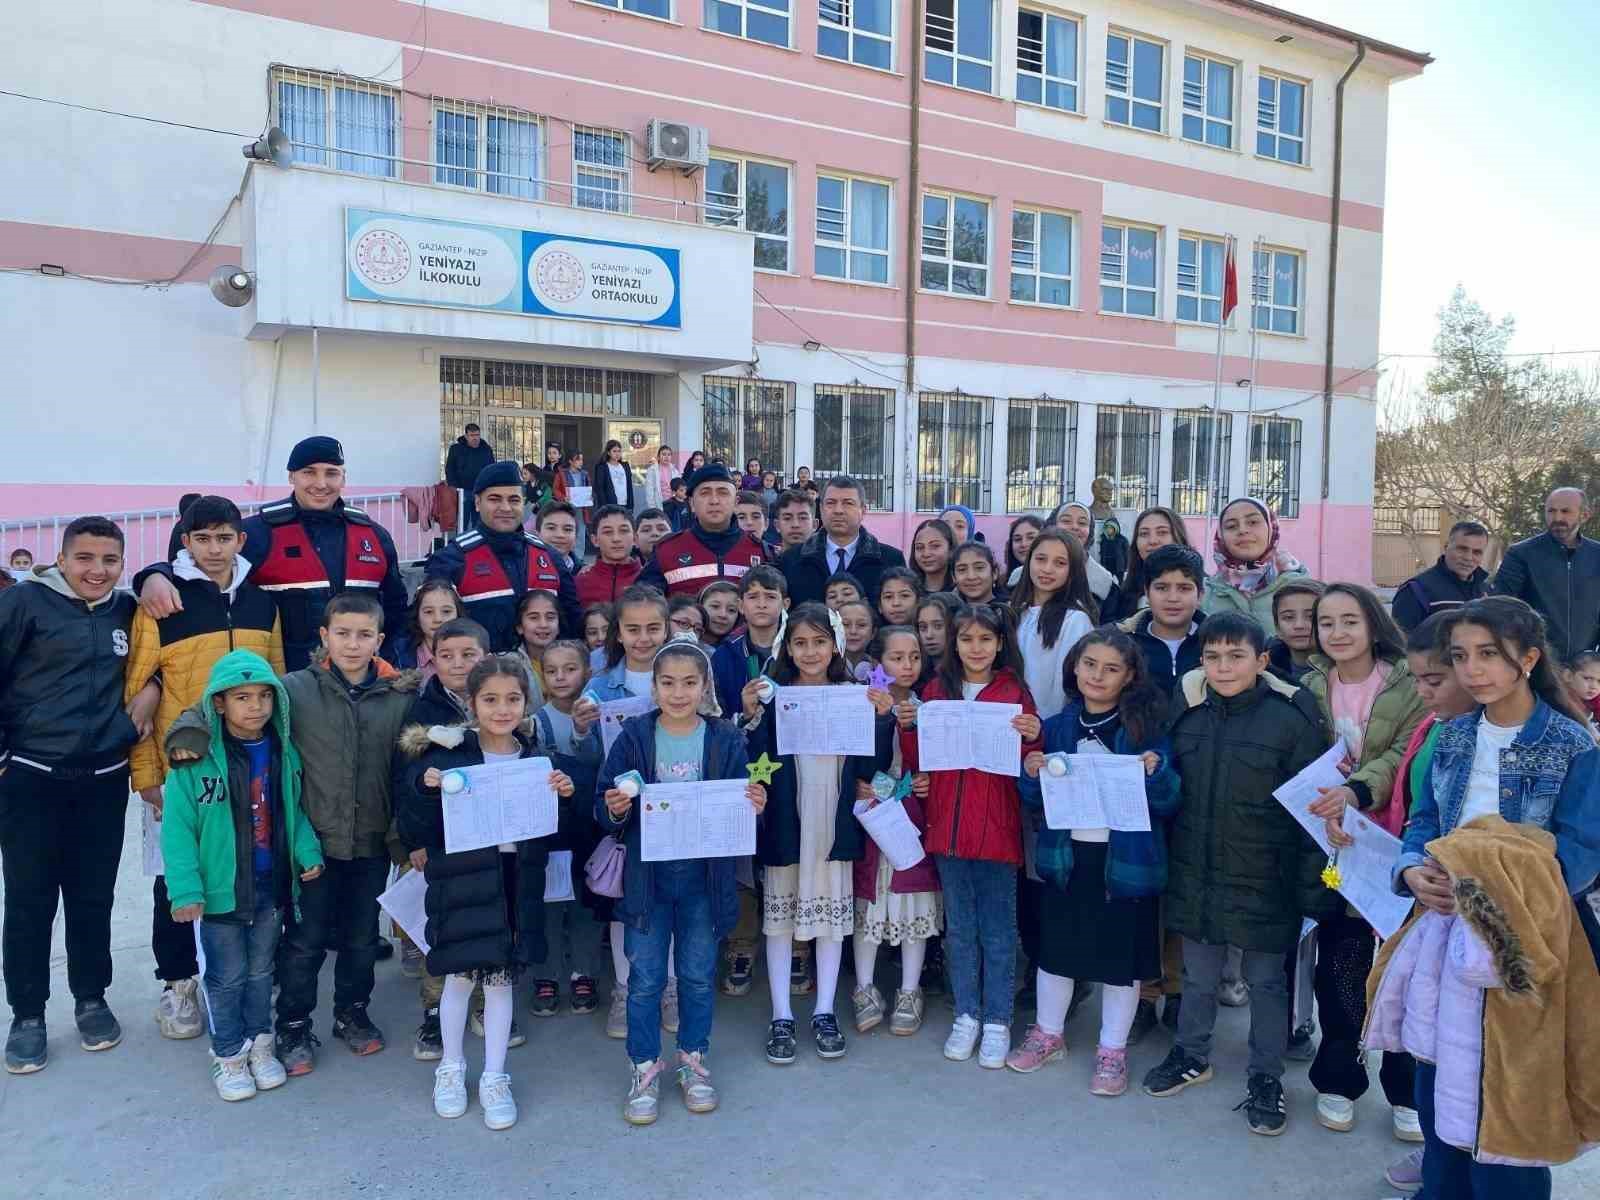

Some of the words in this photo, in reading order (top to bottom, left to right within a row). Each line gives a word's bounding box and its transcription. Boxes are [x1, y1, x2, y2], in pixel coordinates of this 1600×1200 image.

[419, 255, 476, 271] YENİYAZI
[419, 268, 481, 287] İLKOKULU
[591, 274, 641, 289] YENİYAZI
[591, 289, 658, 304] ORTAOKULU
[111, 628, 129, 657] S
